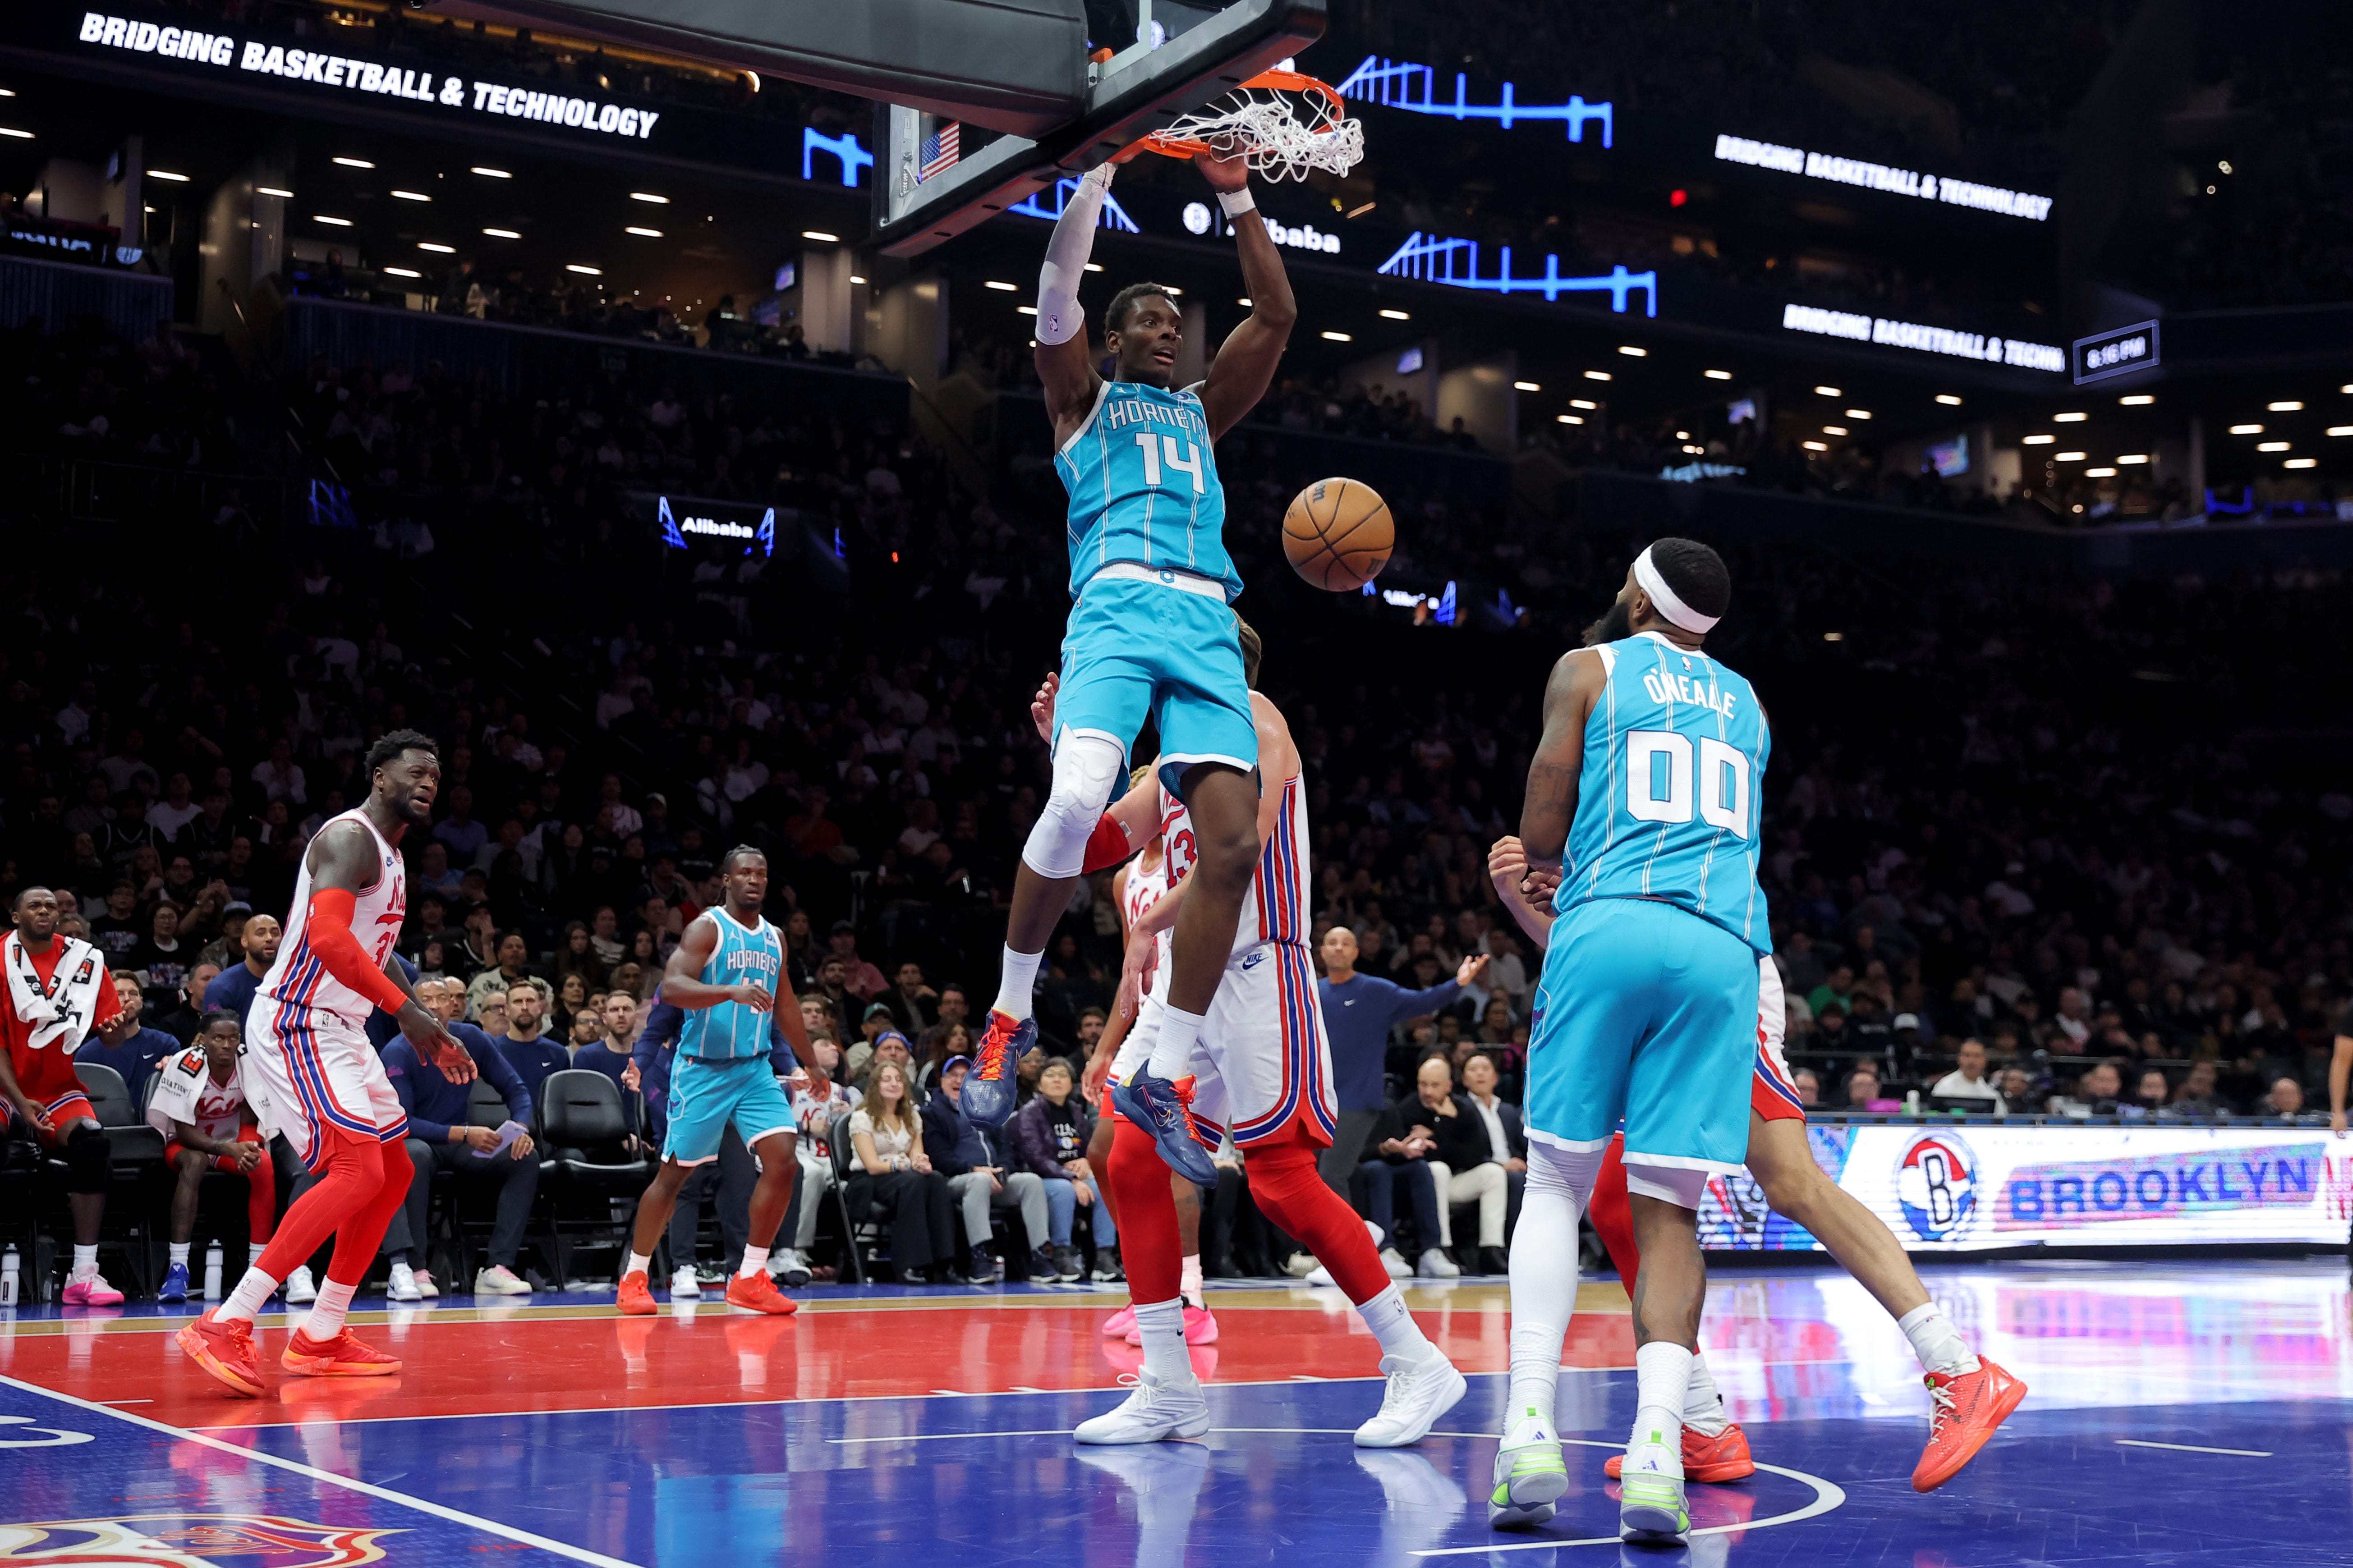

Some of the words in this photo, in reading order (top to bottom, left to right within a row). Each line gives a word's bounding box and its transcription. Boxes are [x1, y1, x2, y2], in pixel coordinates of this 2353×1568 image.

[79, 12, 234, 66] BRIDGING
[240, 41, 435, 102] BASKETBALL
[439, 76, 465, 107] &
[473, 81, 659, 139] TECHNOLOGY
[1805, 151, 1919, 197] BASKETBALL
[1106, 399, 1205, 448] HORNETS
[1135, 432, 1205, 495] 14
[681, 517, 754, 538] Alibaba
[1643, 667, 1736, 720] O'NEALE
[1627, 729, 1750, 841] 00
[727, 949, 777, 976] HORNETS
[1246, 953, 1263, 963] NIKE
[2010, 1157, 2308, 1220] BROOKLYN
